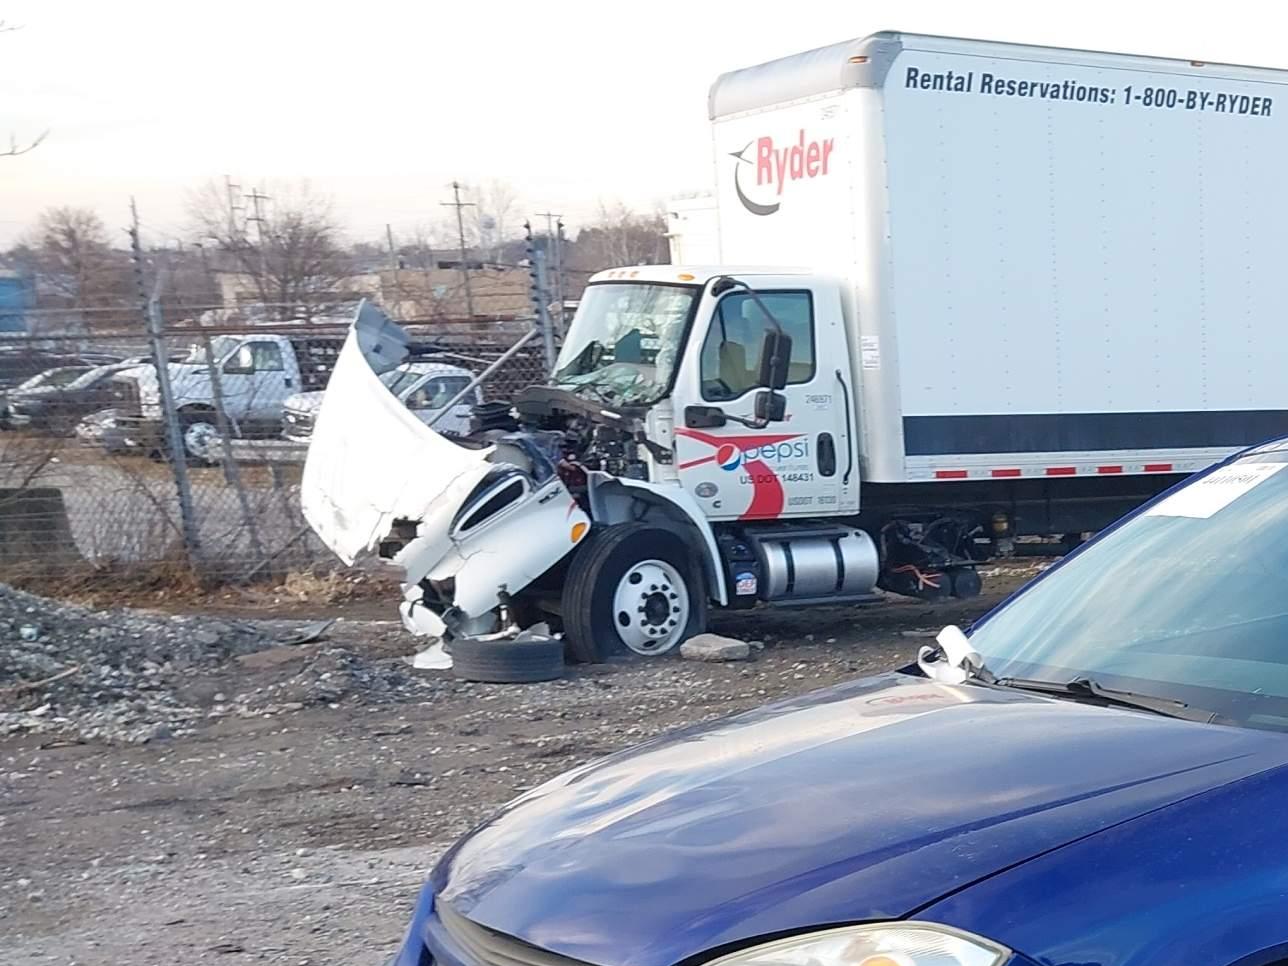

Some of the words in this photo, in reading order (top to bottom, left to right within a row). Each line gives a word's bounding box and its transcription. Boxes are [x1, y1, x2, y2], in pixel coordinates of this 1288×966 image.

[904, 67, 973, 93] Rental
[980, 73, 1117, 104] Reservations:
[1123, 85, 1273, 117] 1-800-BY-RYDER
[757, 128, 834, 196] Ryder
[744, 438, 809, 464] pepsi
[740, 474, 755, 485] US
